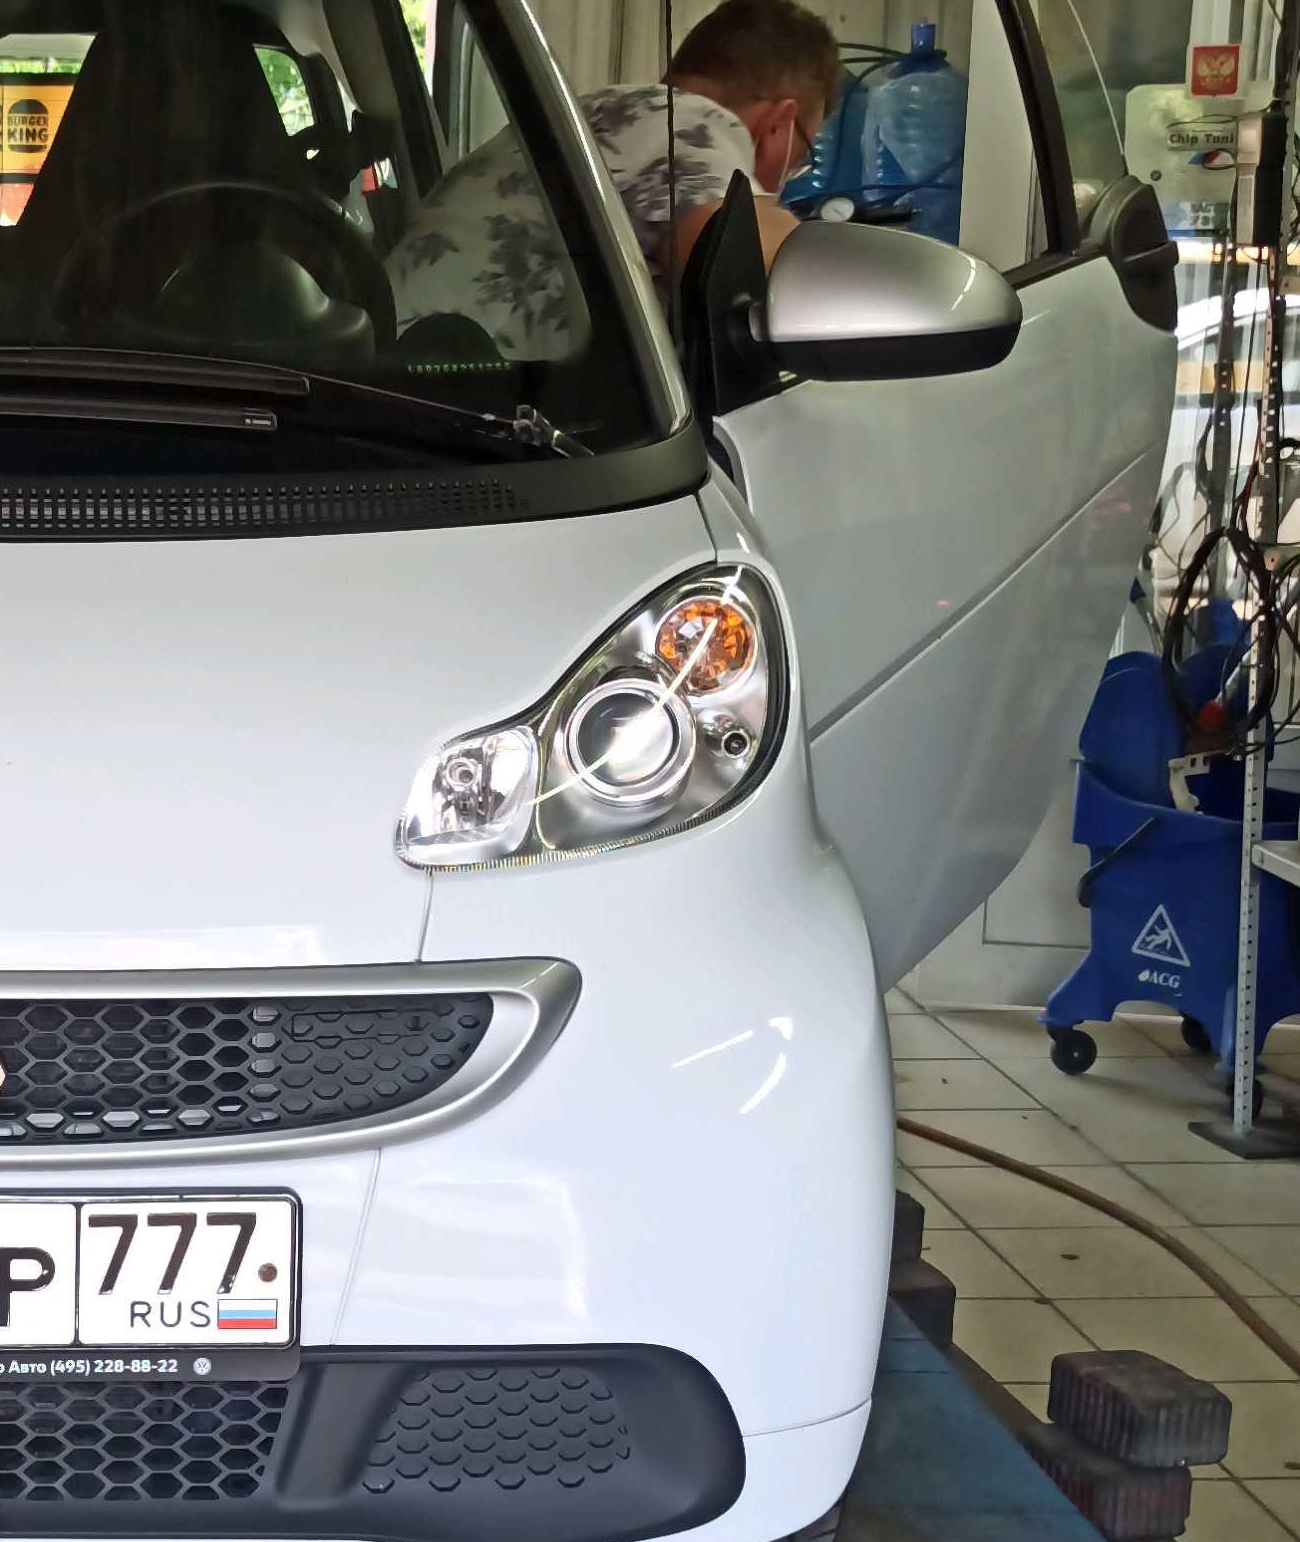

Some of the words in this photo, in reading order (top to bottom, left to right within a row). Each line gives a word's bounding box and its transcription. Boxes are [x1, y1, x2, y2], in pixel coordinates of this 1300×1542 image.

[7, 127, 50, 143] KING
[1169, 132, 1199, 147] Chip
[87, 1211, 258, 1296] 777
[129, 1300, 212, 1328] RUS
[7, 1359, 47, 1374] Авто
[50, 1358, 91, 1377] (495)
[93, 1358, 179, 1374] 228-88-22
